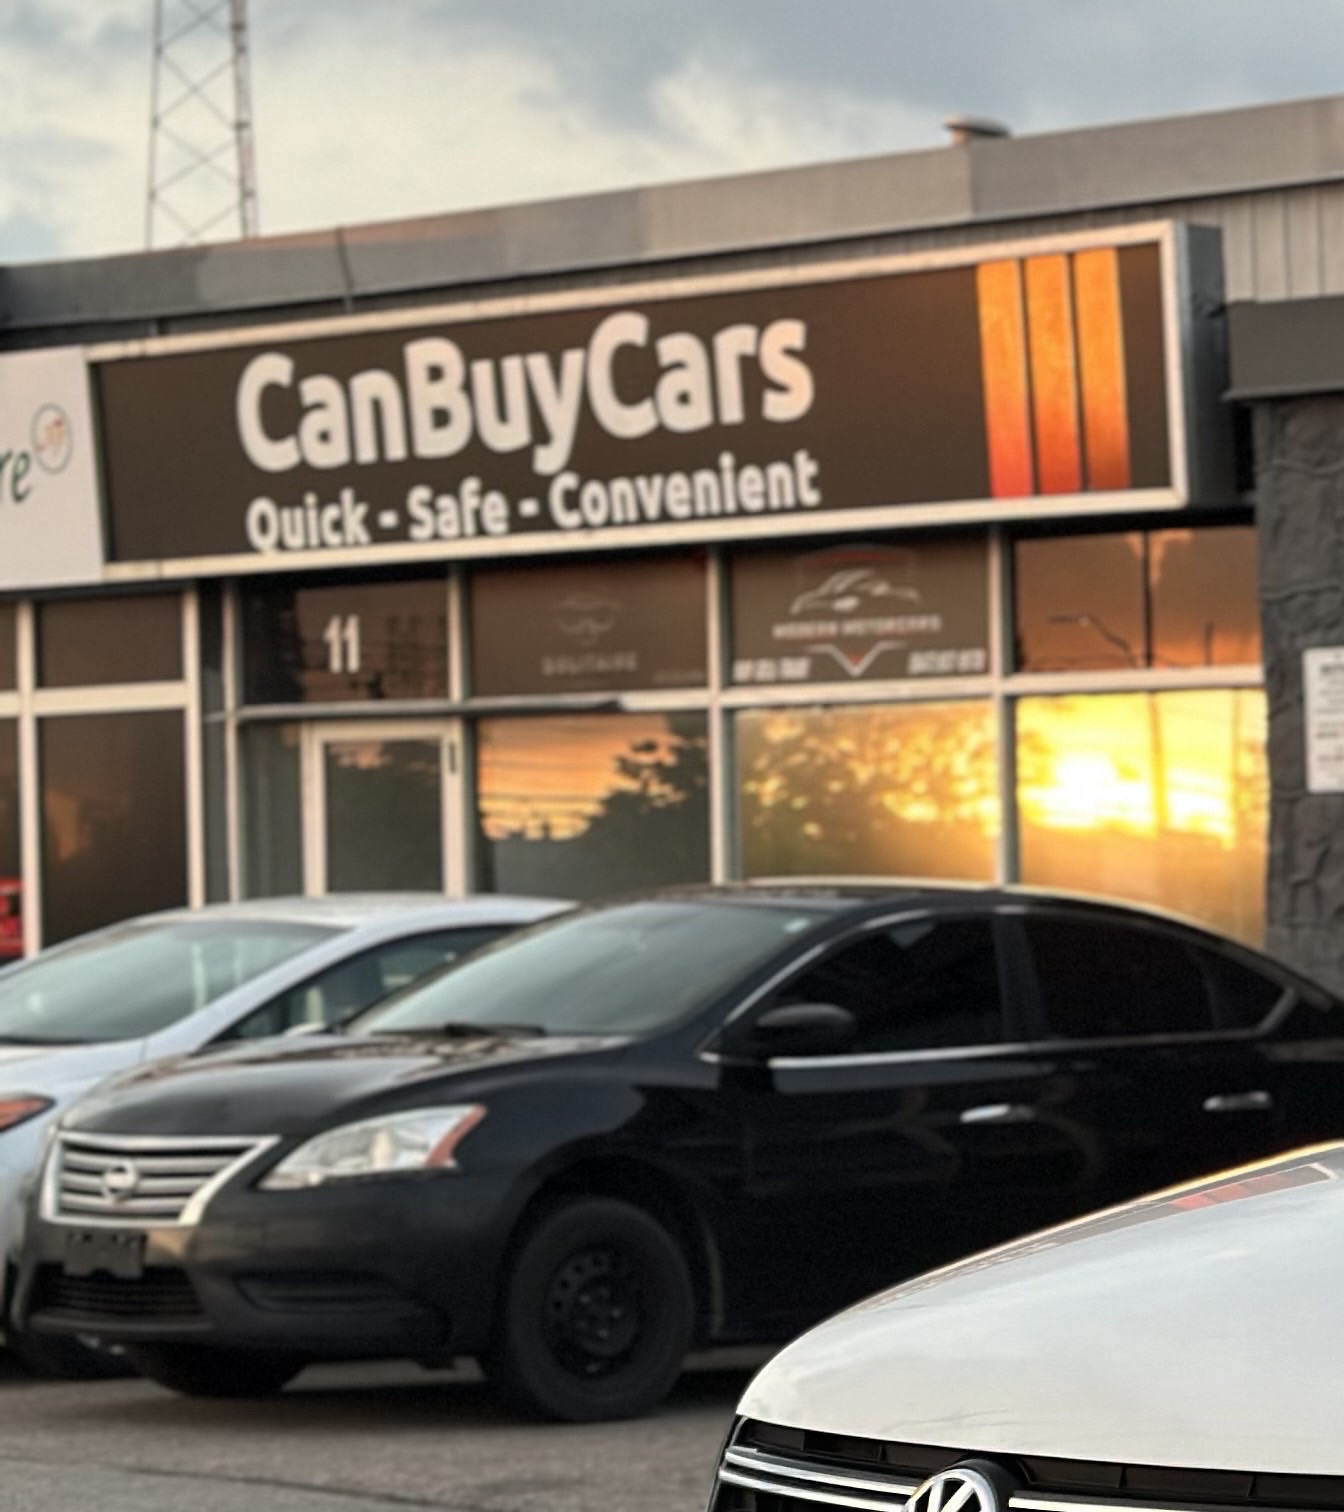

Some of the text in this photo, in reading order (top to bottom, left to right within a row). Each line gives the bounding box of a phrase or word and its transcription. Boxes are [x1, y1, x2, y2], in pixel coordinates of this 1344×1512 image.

[239, 312, 815, 473] CanBuyCars
[246, 488, 372, 556] Quick
[407, 477, 511, 540] Safe
[549, 449, 822, 531] Convenient
[322, 614, 361, 674] 11
